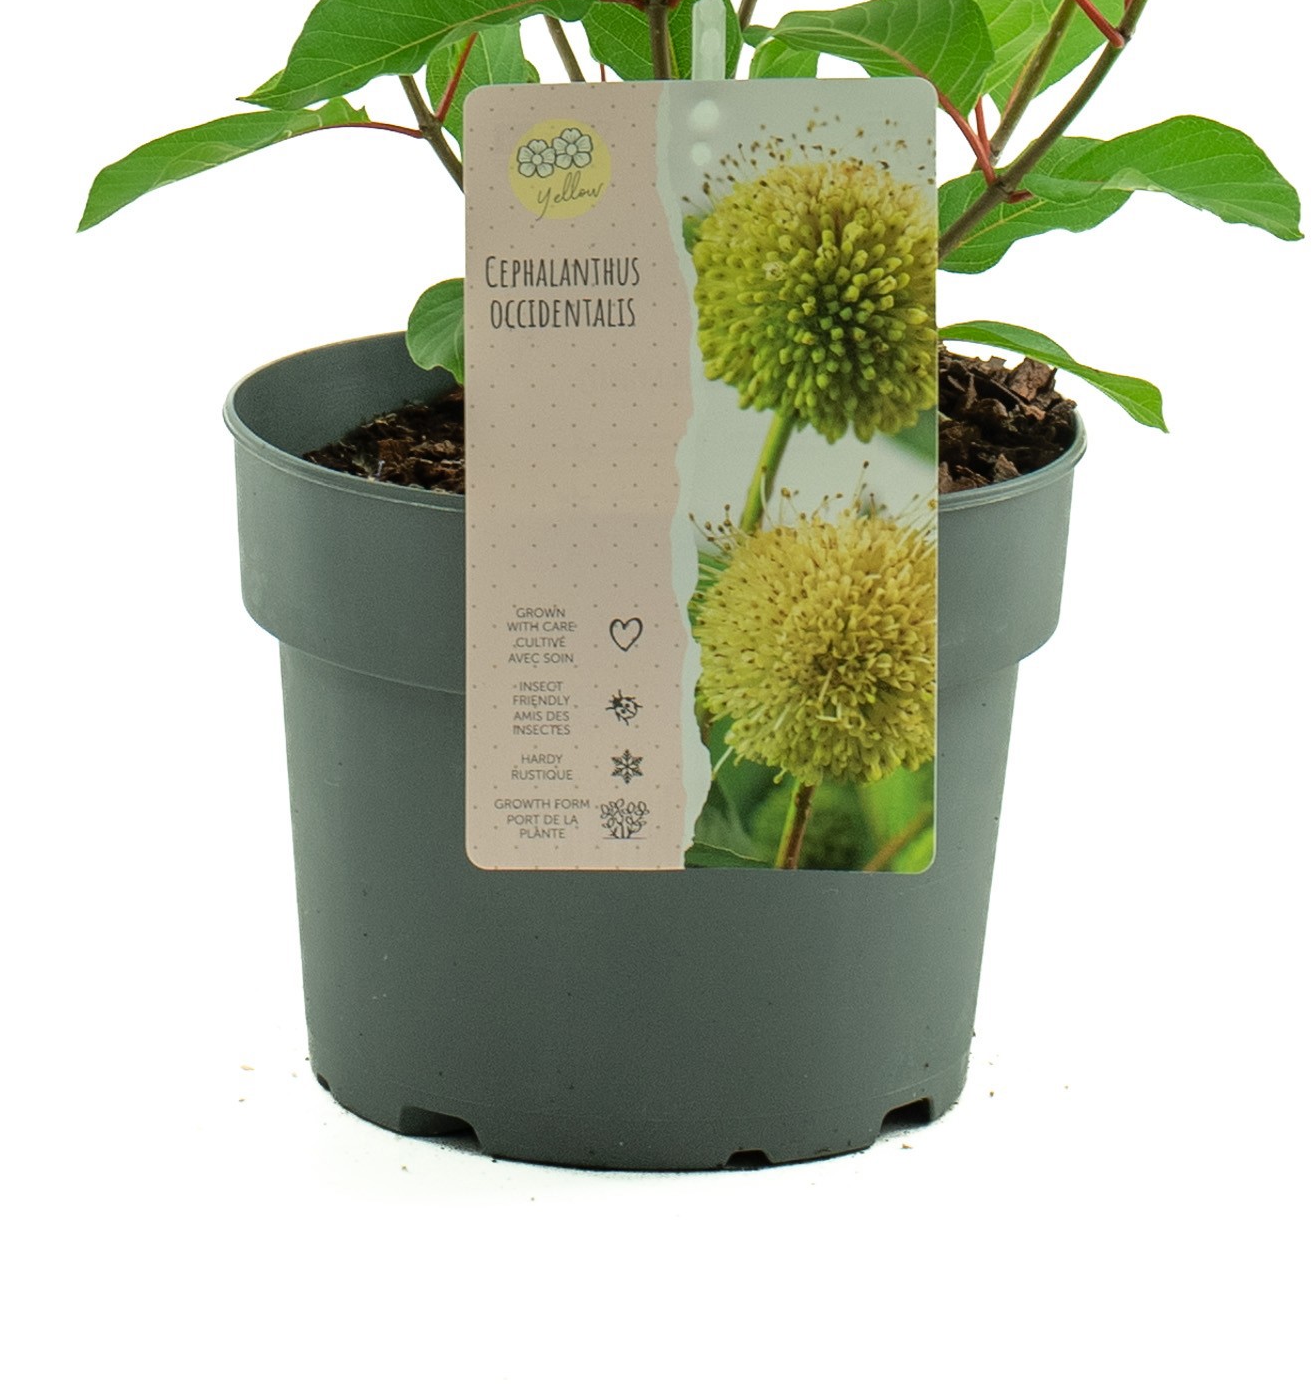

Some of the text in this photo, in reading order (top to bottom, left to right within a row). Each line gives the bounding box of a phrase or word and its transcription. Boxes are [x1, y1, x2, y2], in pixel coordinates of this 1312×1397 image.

[516, 607, 566, 618] GROWN
[507, 621, 574, 632] WITH CARE
[516, 636, 566, 648] CULTIVÉ
[508, 653, 574, 664] AVEC SOIN
[519, 681, 564, 692] INSECT
[513, 695, 570, 706] FRIENDLY
[513, 711, 570, 721] AMIS DES
[513, 724, 571, 736] INSECTES
[521, 753, 563, 764] HARDY
[511, 769, 573, 781] RUSTIQUE
[494, 798, 590, 810] GROWTH FORM
[507, 814, 578, 825] PORT DE LA
[519, 828, 566, 839] PLANTE
